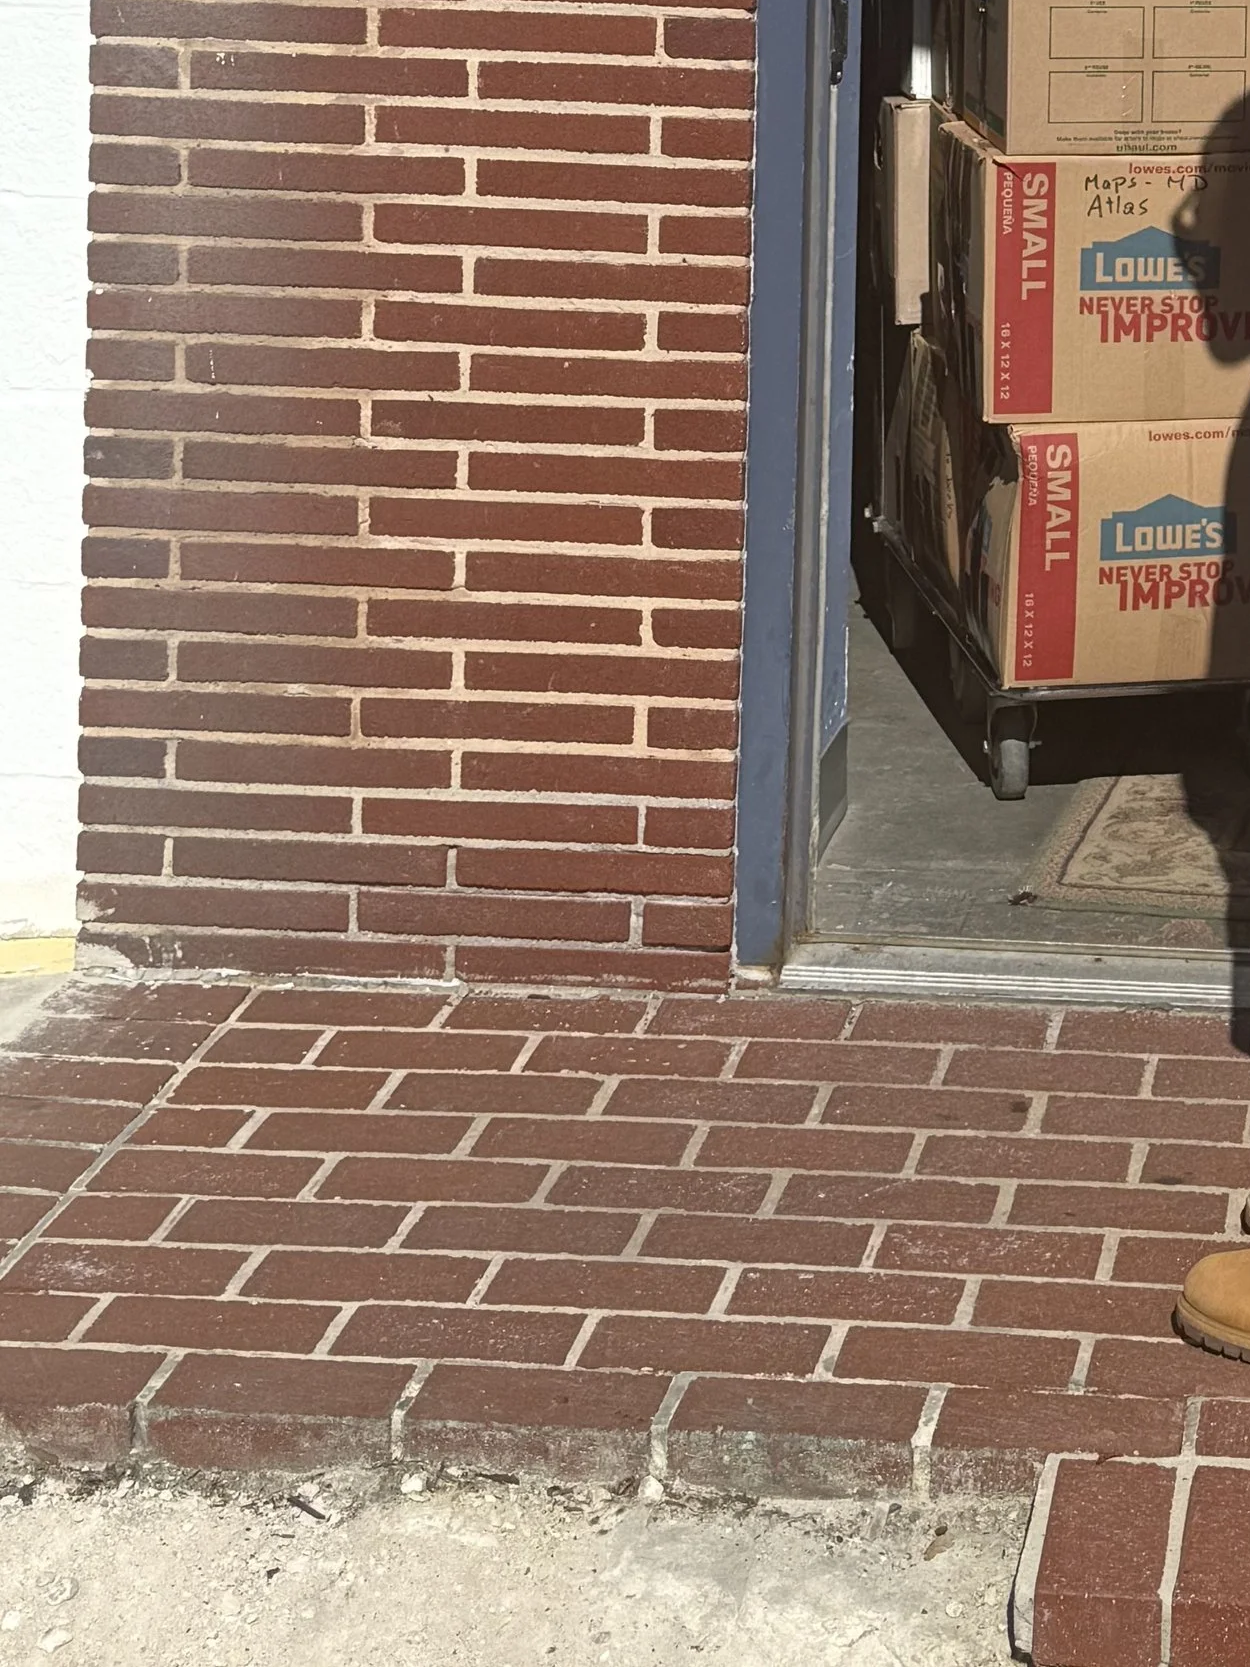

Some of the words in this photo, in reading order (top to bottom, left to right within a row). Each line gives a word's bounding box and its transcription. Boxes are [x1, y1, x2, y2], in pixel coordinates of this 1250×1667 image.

[1116, 143, 1178, 152] uhaul.com
[1084, 174, 1137, 192] Maps
[1002, 172, 1013, 235] PEQUEÑA
[1087, 194, 1150, 219] Atlas
[1021, 172, 1049, 300] SMALL
[1095, 252, 1206, 283] LOWE'S
[1079, 296, 1154, 315] NEVER
[1160, 295, 1219, 315] STOP
[1000, 322, 1010, 337] 16
[999, 354, 1010, 369] 12
[999, 385, 1010, 400] 12
[1027, 445, 1038, 507] PEQUEÑA
[1045, 444, 1072, 571] SMALL
[1115, 518, 1224, 553] LOWE'S
[1098, 563, 1173, 584] NEVER
[1179, 560, 1235, 580] STOP
[1024, 592, 1034, 607] 16
[1023, 624, 1033, 637] 12
[1022, 654, 1033, 668] 12
